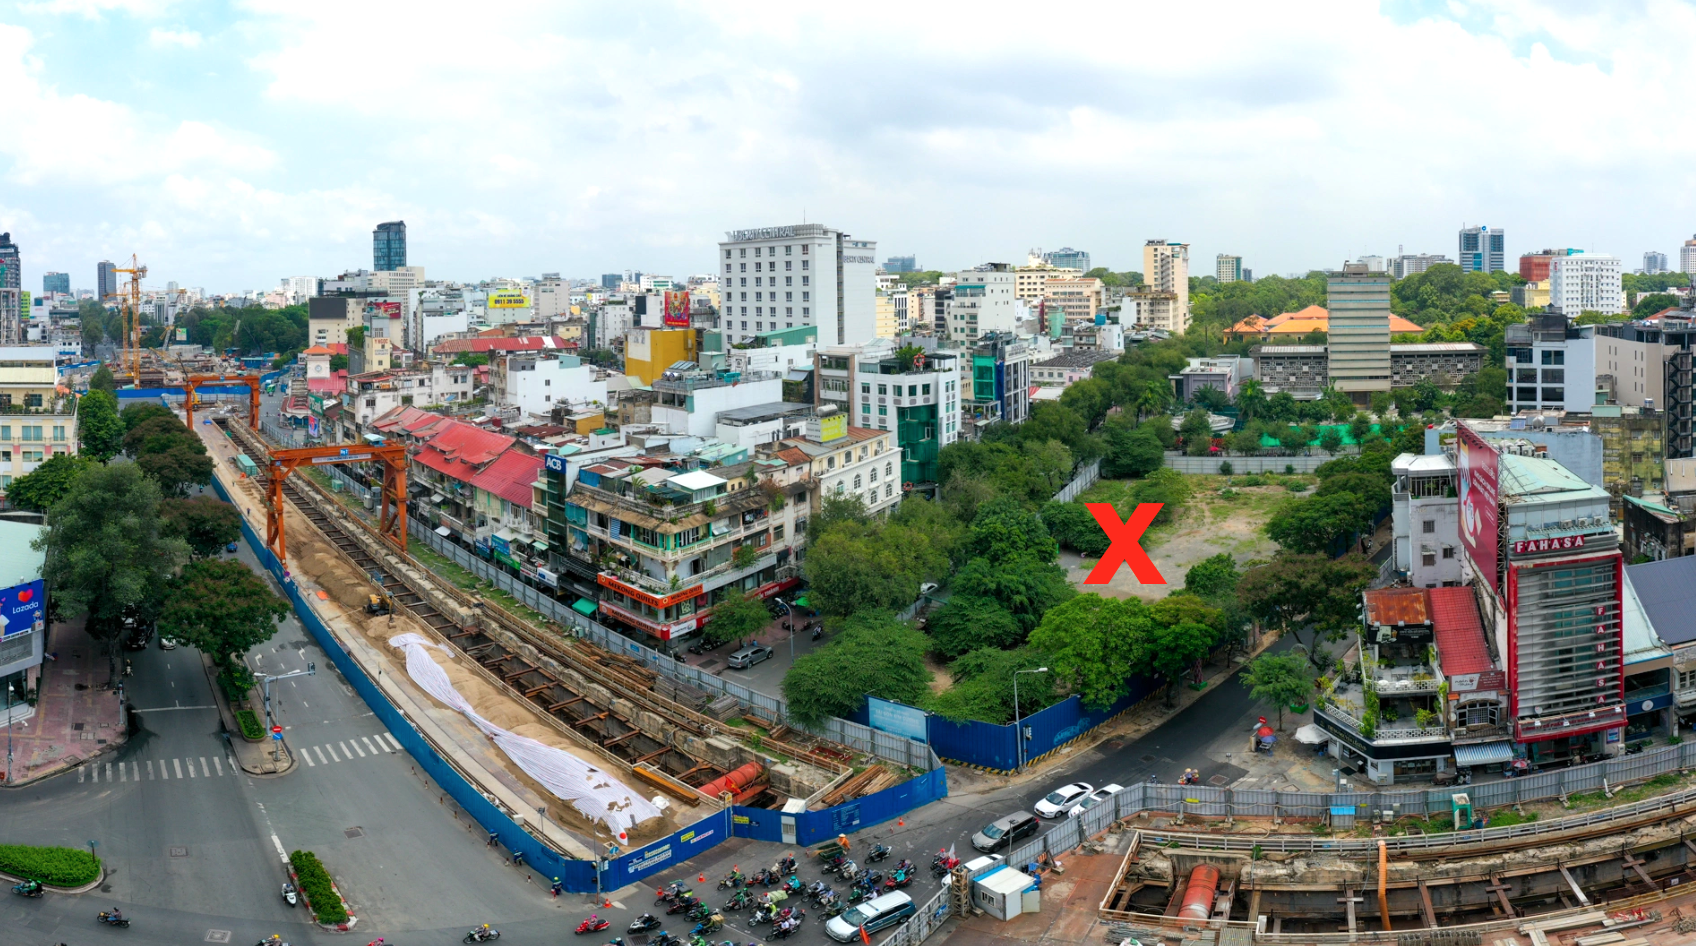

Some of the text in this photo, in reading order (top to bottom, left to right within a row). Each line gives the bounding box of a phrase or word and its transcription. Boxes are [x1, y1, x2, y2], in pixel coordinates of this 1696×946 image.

[546, 456, 562, 470] ACB
[1516, 536, 1584, 553] FAHASA
[608, 580, 635, 596] MEKONG
[636, 592, 659, 607] QUILTS
[13, 602, 38, 614] Lazada
[612, 610, 635, 623] MEKONG
[636, 619, 656, 632] QUILTS
